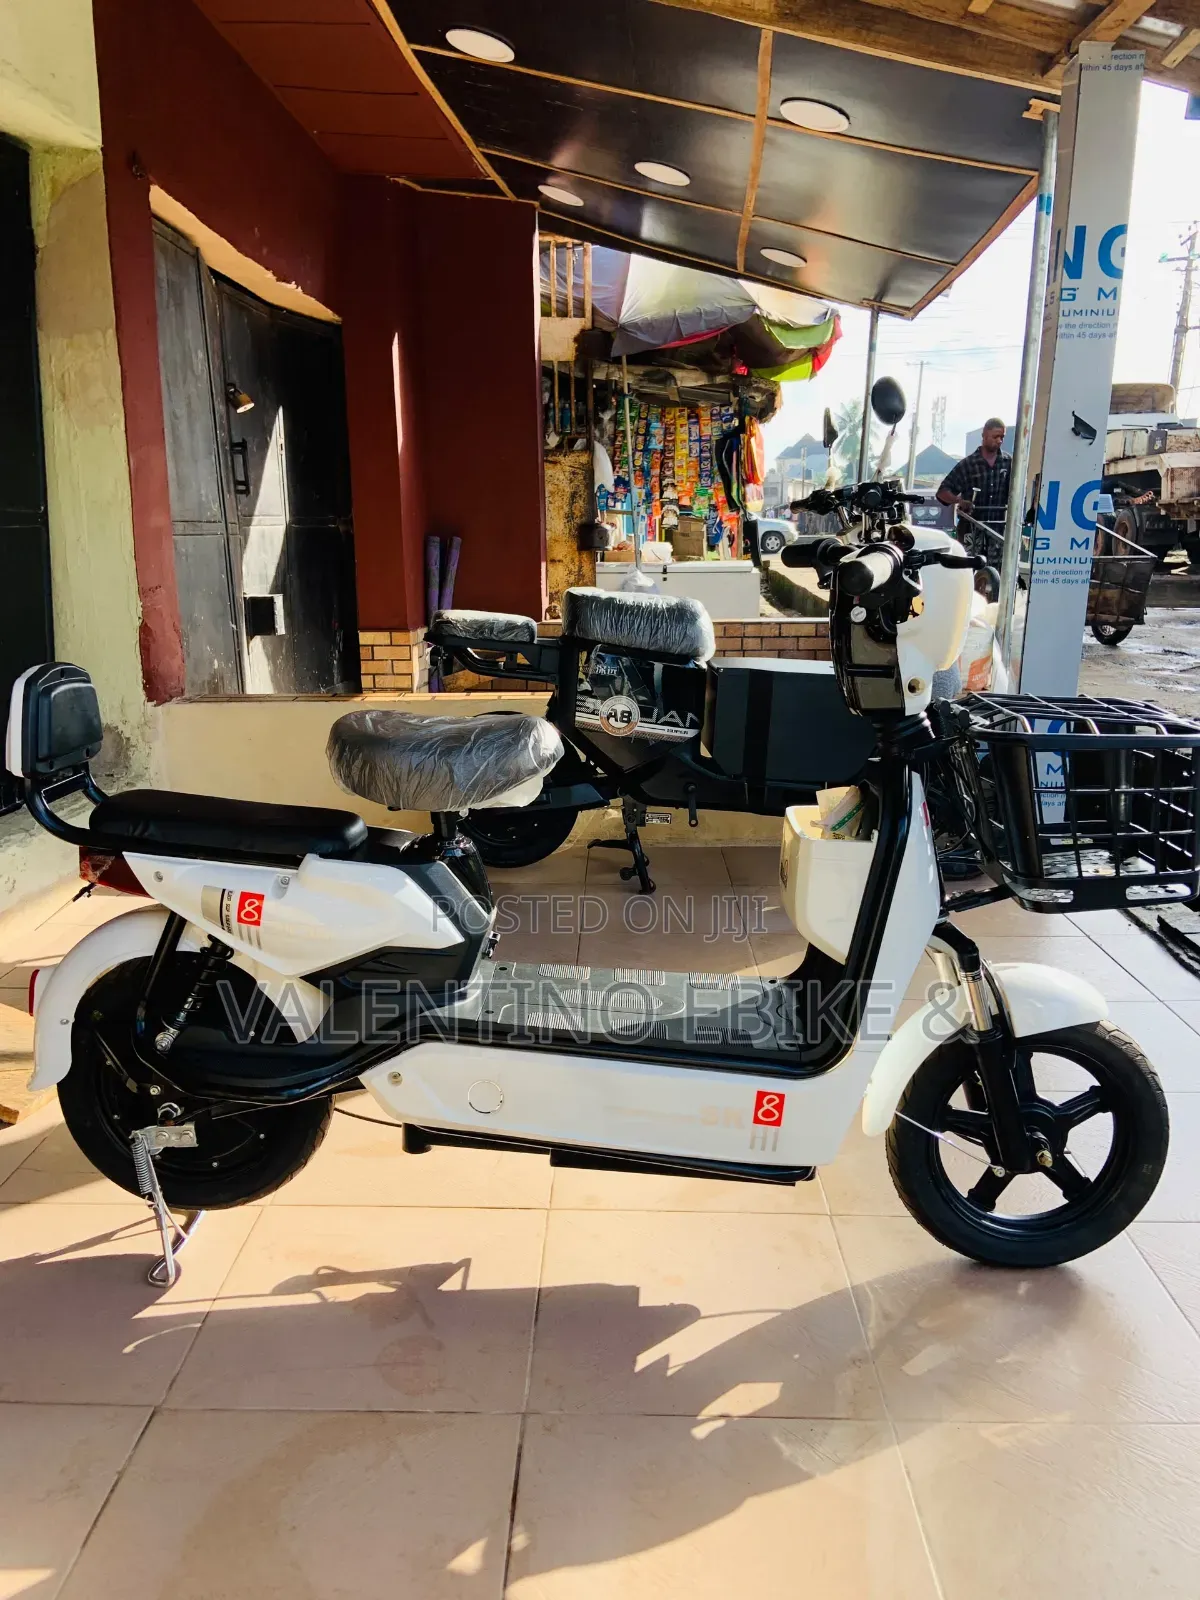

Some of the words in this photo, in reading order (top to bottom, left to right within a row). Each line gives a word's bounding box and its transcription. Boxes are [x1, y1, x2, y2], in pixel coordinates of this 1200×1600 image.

[1114, 64, 1132, 72] days
[1135, 63, 1144, 71] af
[1060, 308, 1117, 317] UMINIU
[1064, 321, 1077, 330] the
[1079, 321, 1111, 330] direction
[1077, 331, 1086, 339] 45
[1089, 331, 1106, 340] days
[1032, 556, 1093, 565] UMINIU
[1039, 568, 1050, 576] the
[1052, 568, 1083, 576] direction
[1061, 577, 1079, 585] days
